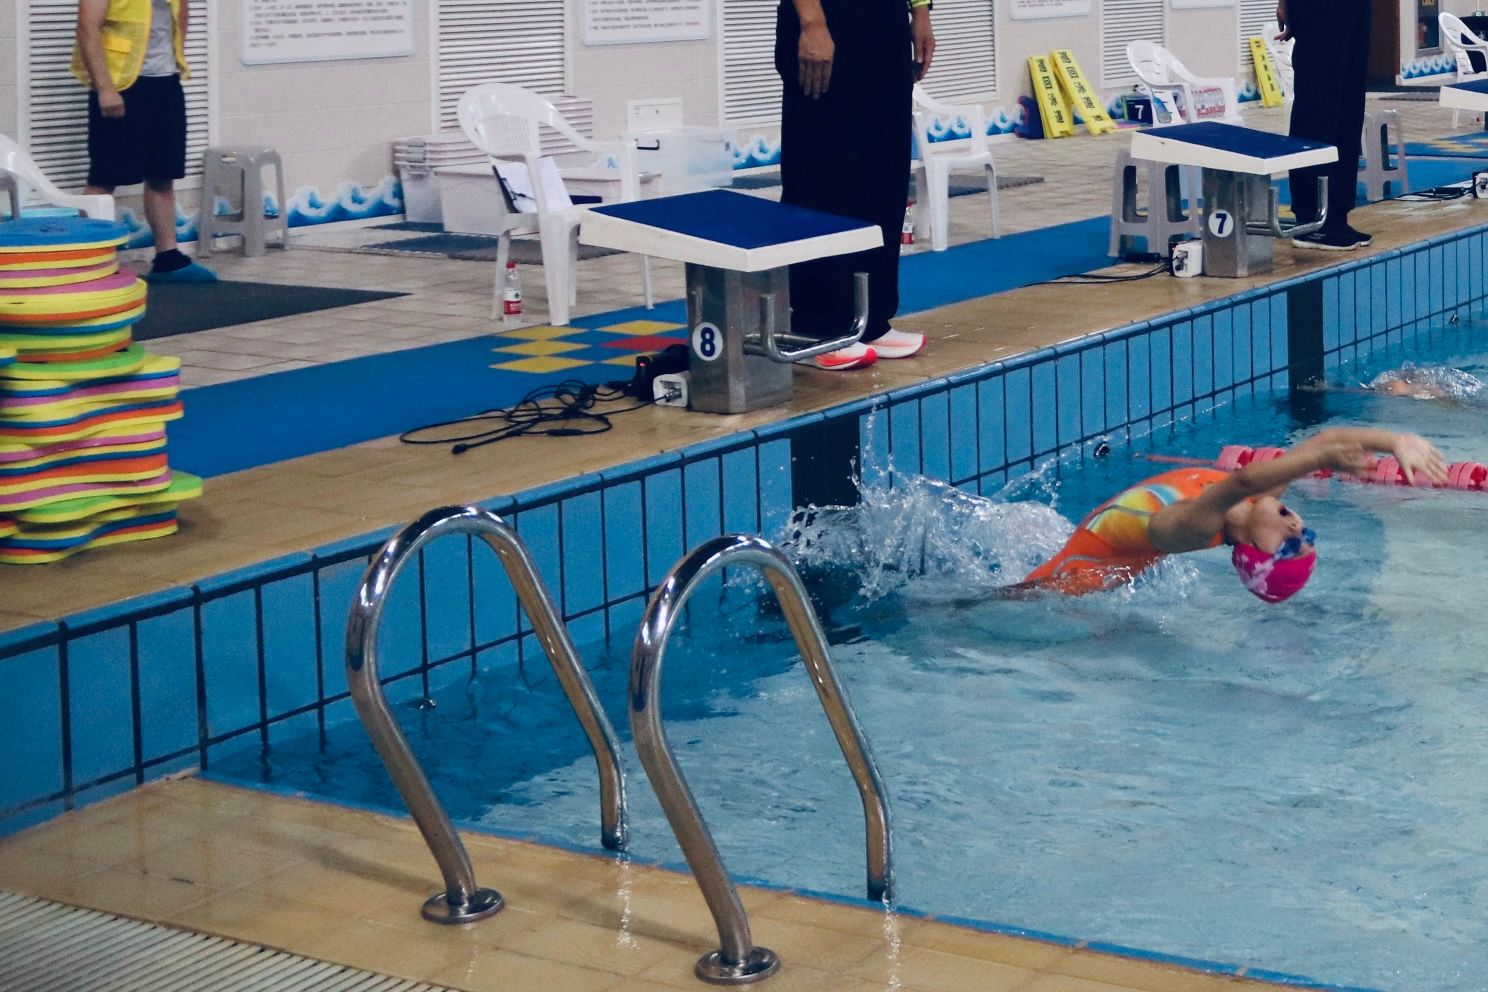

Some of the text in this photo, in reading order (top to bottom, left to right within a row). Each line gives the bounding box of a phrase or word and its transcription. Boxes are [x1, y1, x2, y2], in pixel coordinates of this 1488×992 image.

[1134, 104, 1144, 119] 7
[1215, 212, 1228, 234] 7
[700, 326, 716, 357] 8
